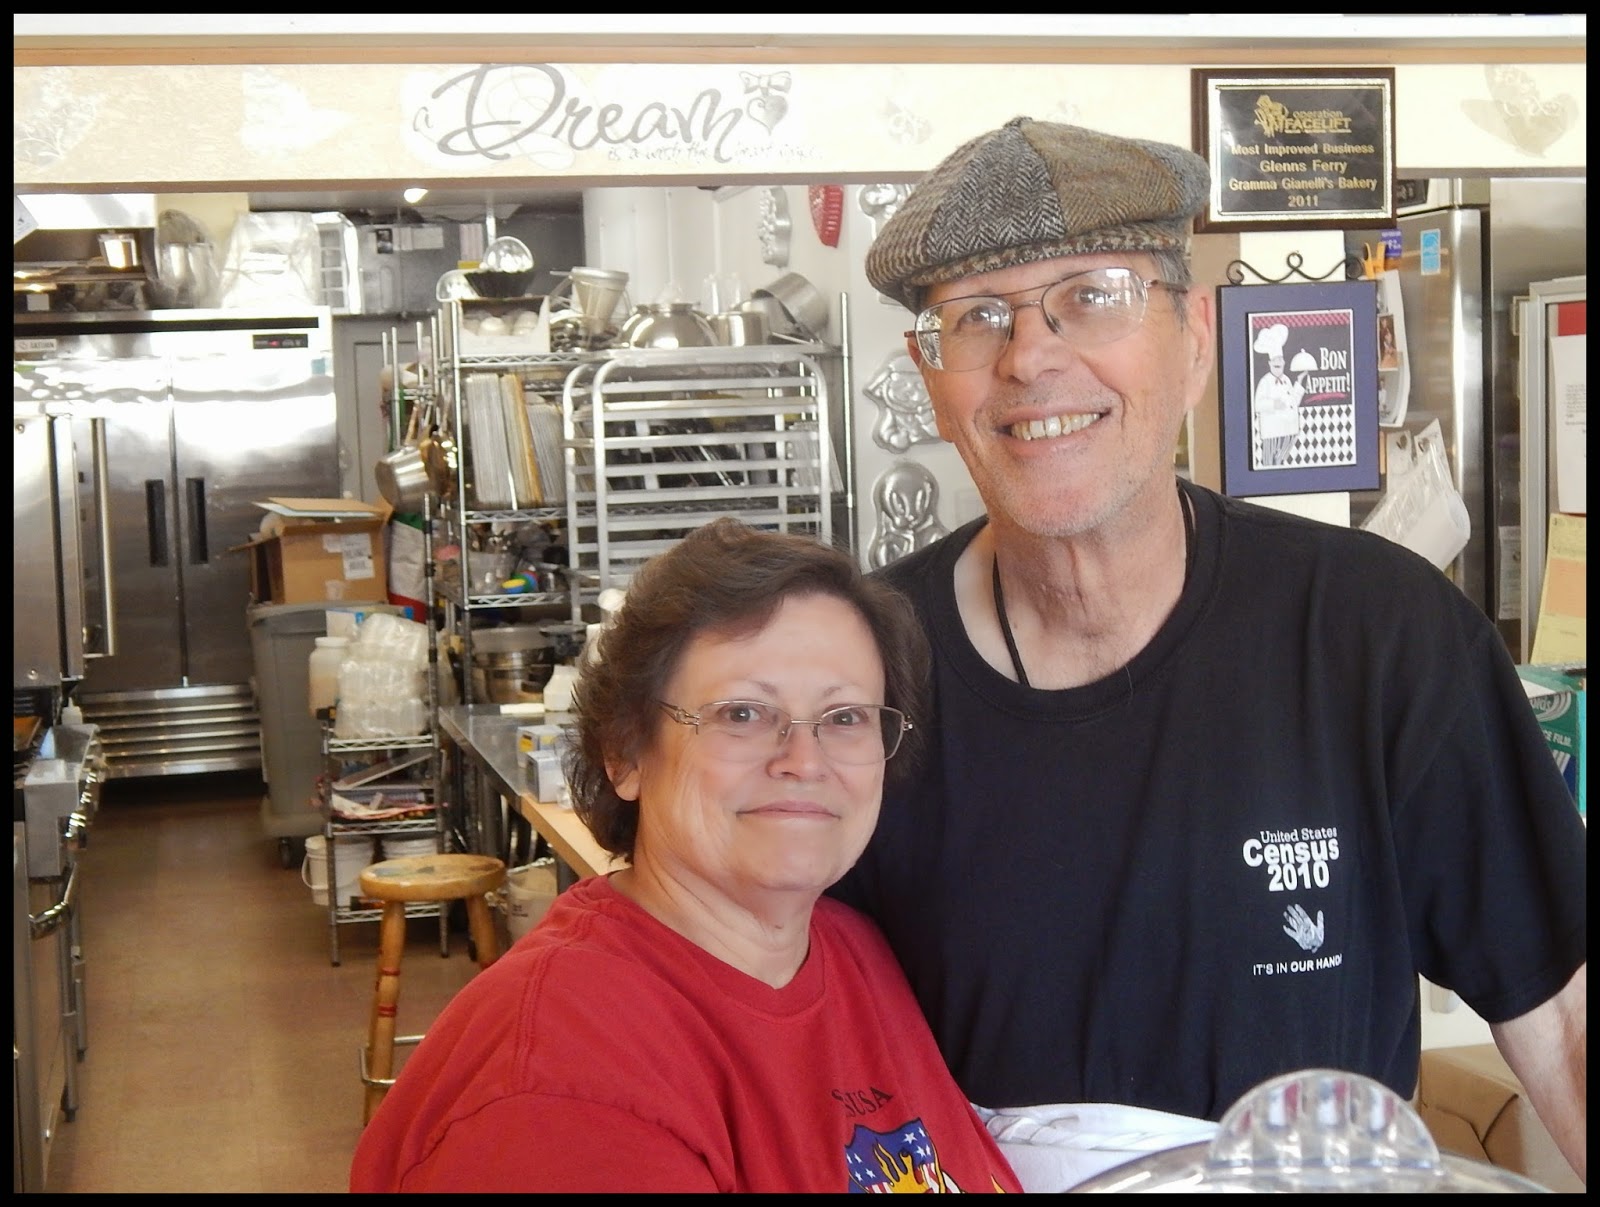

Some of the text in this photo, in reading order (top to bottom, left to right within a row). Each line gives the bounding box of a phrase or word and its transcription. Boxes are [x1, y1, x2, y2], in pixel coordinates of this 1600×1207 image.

[431, 63, 743, 163] Dream
[1293, 108, 1343, 118] operation
[1284, 117, 1353, 129] FACELIFT
[1231, 143, 1374, 157] Most Improved Business
[1260, 159, 1347, 174] Glenns Ferry
[1229, 177, 1377, 191] Gramma Gianelli's Bakery
[1288, 195, 1319, 207] 2011
[1320, 347, 1347, 370] BON
[1305, 372, 1350, 394] APPETIT!
[1260, 827, 1338, 843] United States
[1243, 838, 1340, 867] Census
[1267, 861, 1330, 891] 2010
[1253, 963, 1274, 976] IT'S
[1276, 962, 1288, 974] IN
[1290, 960, 1314, 972] OUR
